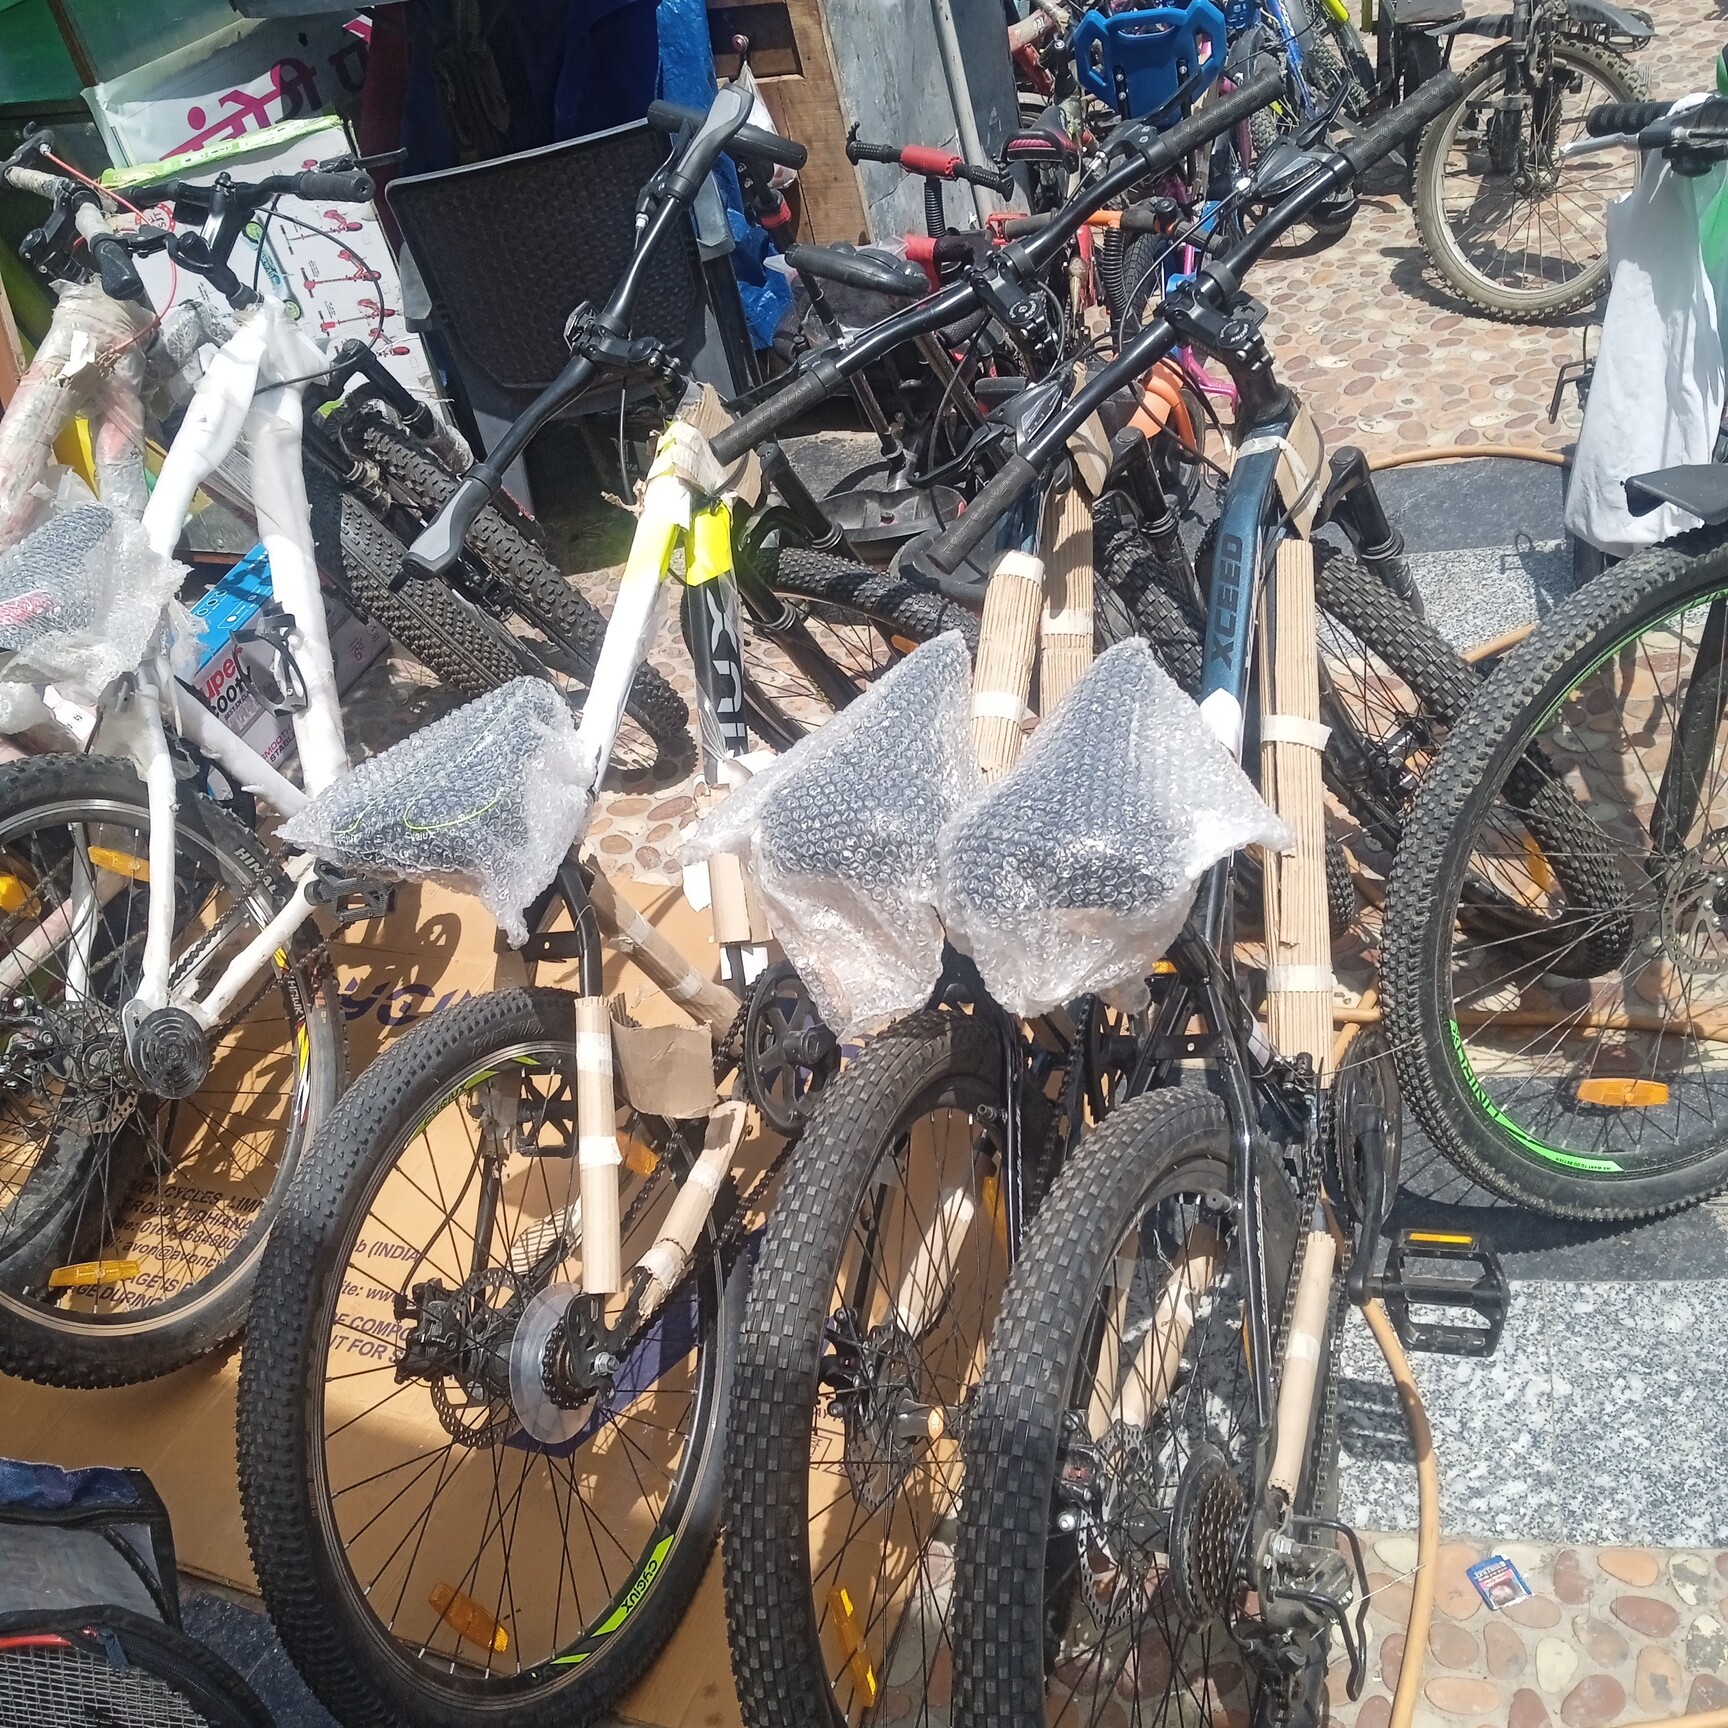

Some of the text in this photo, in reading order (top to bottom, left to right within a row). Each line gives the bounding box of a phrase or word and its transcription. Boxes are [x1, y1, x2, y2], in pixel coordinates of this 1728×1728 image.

[1210, 532, 1244, 672] XCEED
[201, 646, 244, 701] uper
[165, 1187, 223, 1204] CYCLES
[353, 1238, 367, 1254] b
[347, 1338, 388, 1360] FOR
